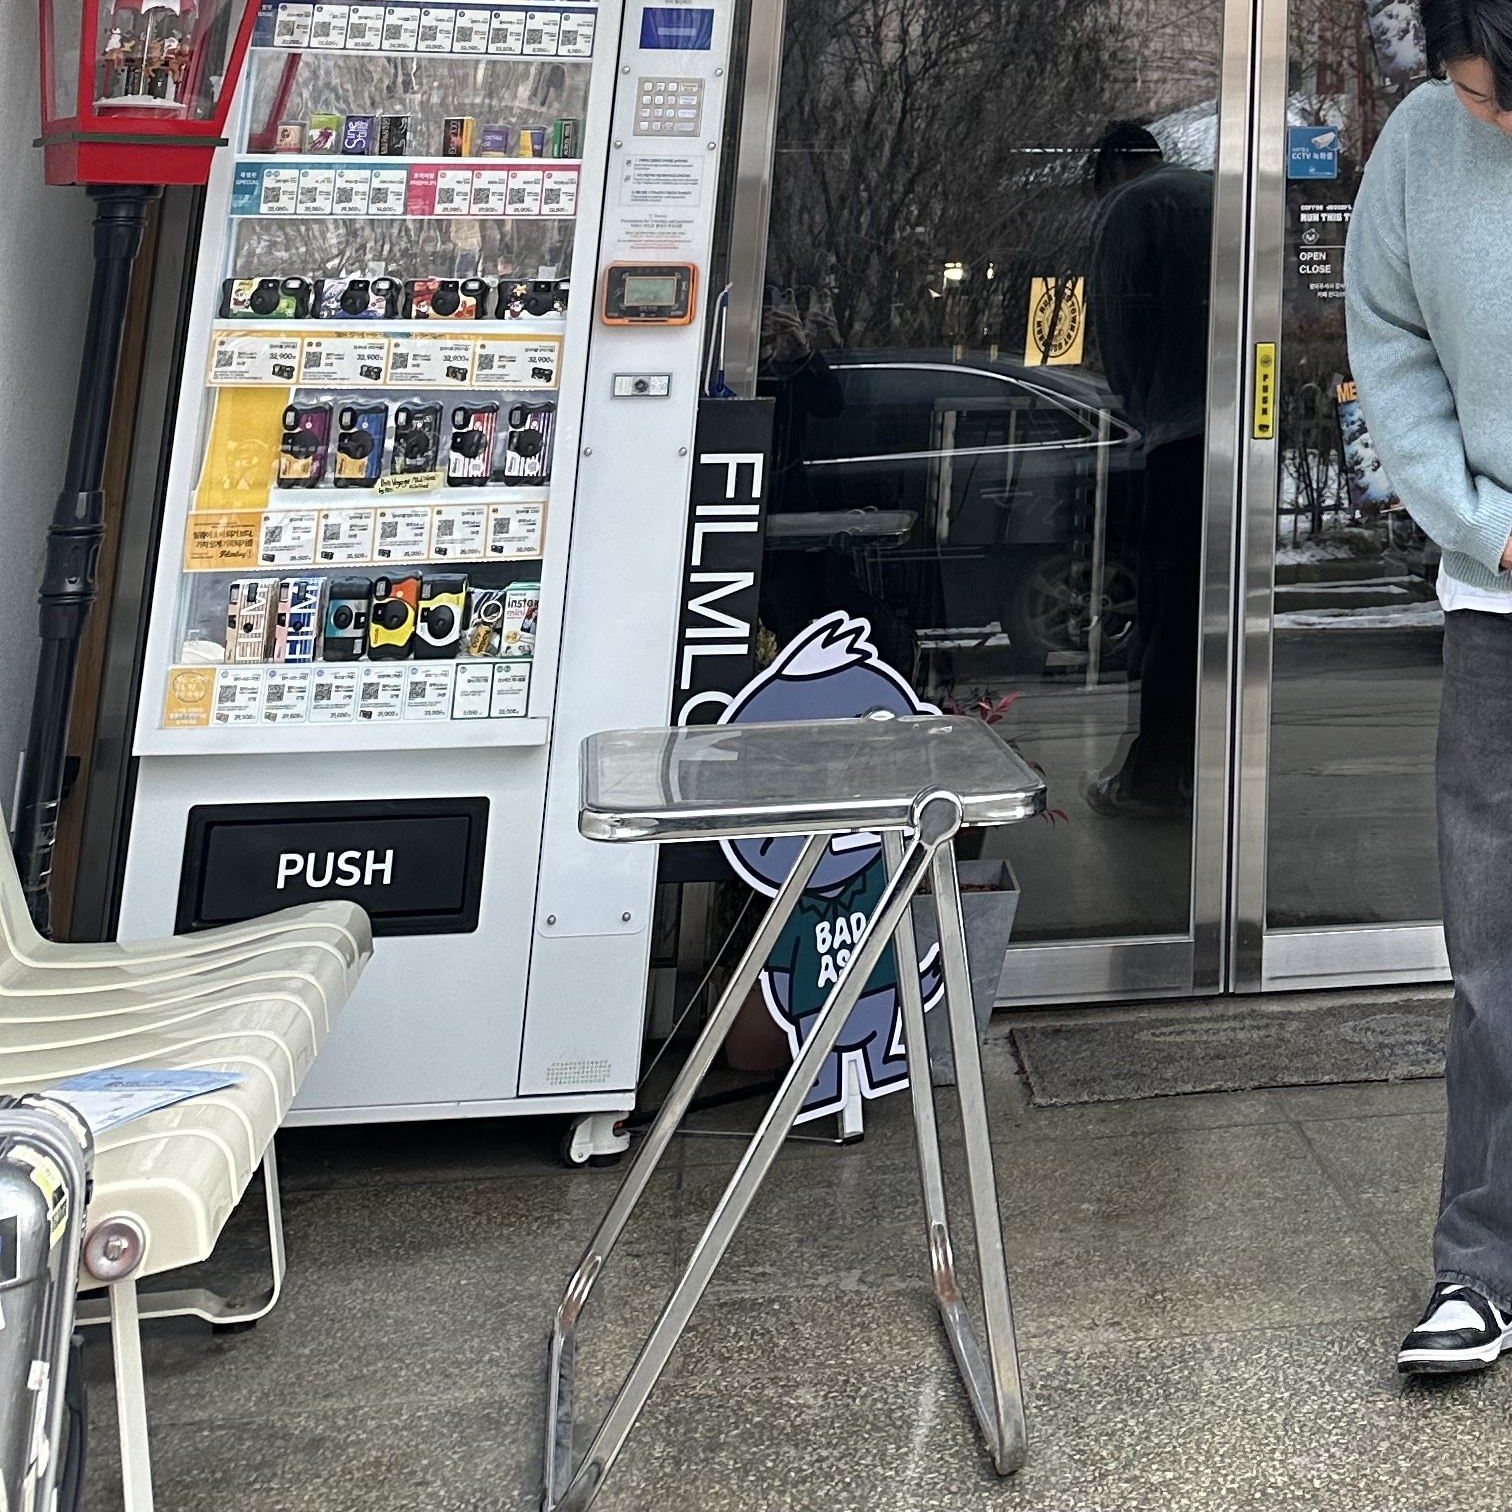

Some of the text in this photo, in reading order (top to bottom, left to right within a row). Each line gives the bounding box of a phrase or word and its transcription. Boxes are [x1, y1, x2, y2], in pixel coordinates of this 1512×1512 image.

[1291, 152, 1312, 160] CCTV
[1299, 251, 1327, 261] OPEN
[1299, 264, 1332, 274] CLOSE
[276, 848, 395, 889] PUSH
[814, 911, 867, 954] BAD
[816, 948, 852, 988] AS
